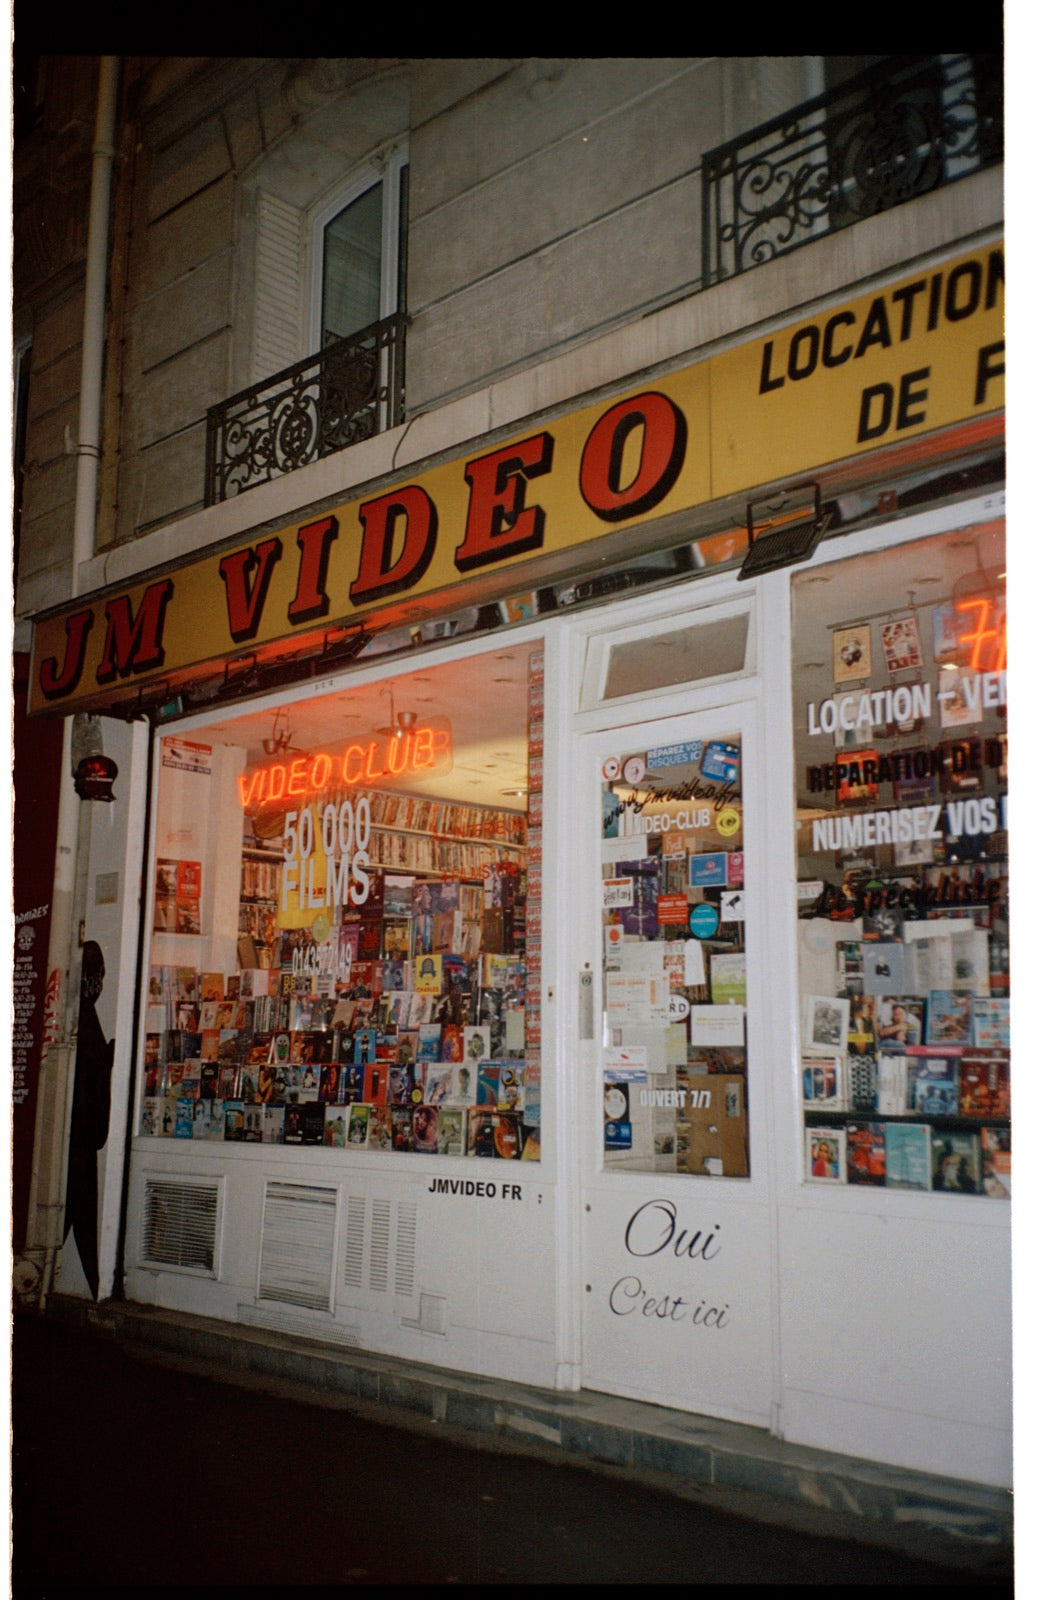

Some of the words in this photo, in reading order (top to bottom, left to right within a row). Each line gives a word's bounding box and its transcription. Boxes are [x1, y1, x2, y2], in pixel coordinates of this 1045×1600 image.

[758, 249, 1005, 396] LOCATION
[856, 366, 931, 444] DE
[974, 339, 1006, 406] F
[39, 579, 173, 700] JM
[218, 390, 687, 641] VIDEO
[807, 683, 931, 736] LOCATION
[237, 753, 332, 808] VIDEO
[342, 728, 435, 785] CLUB
[808, 749, 944, 793] REPARATION
[283, 808, 313, 859] 50
[322, 797, 371, 856] 000
[634, 808, 711, 834] VIDEO-CLUB
[812, 804, 942, 852] NUMERISEZ
[945, 797, 997, 837] VOS
[281, 850, 371, 912] FILMS
[640, 1089, 687, 1108] OUVERT
[428, 1178, 496, 1198] JMVIDEO
[501, 1183, 522, 1201] FR
[625, 1199, 721, 1261] Oui
[609, 1275, 691, 1322] C'est
[692, 1299, 730, 1329] ici
